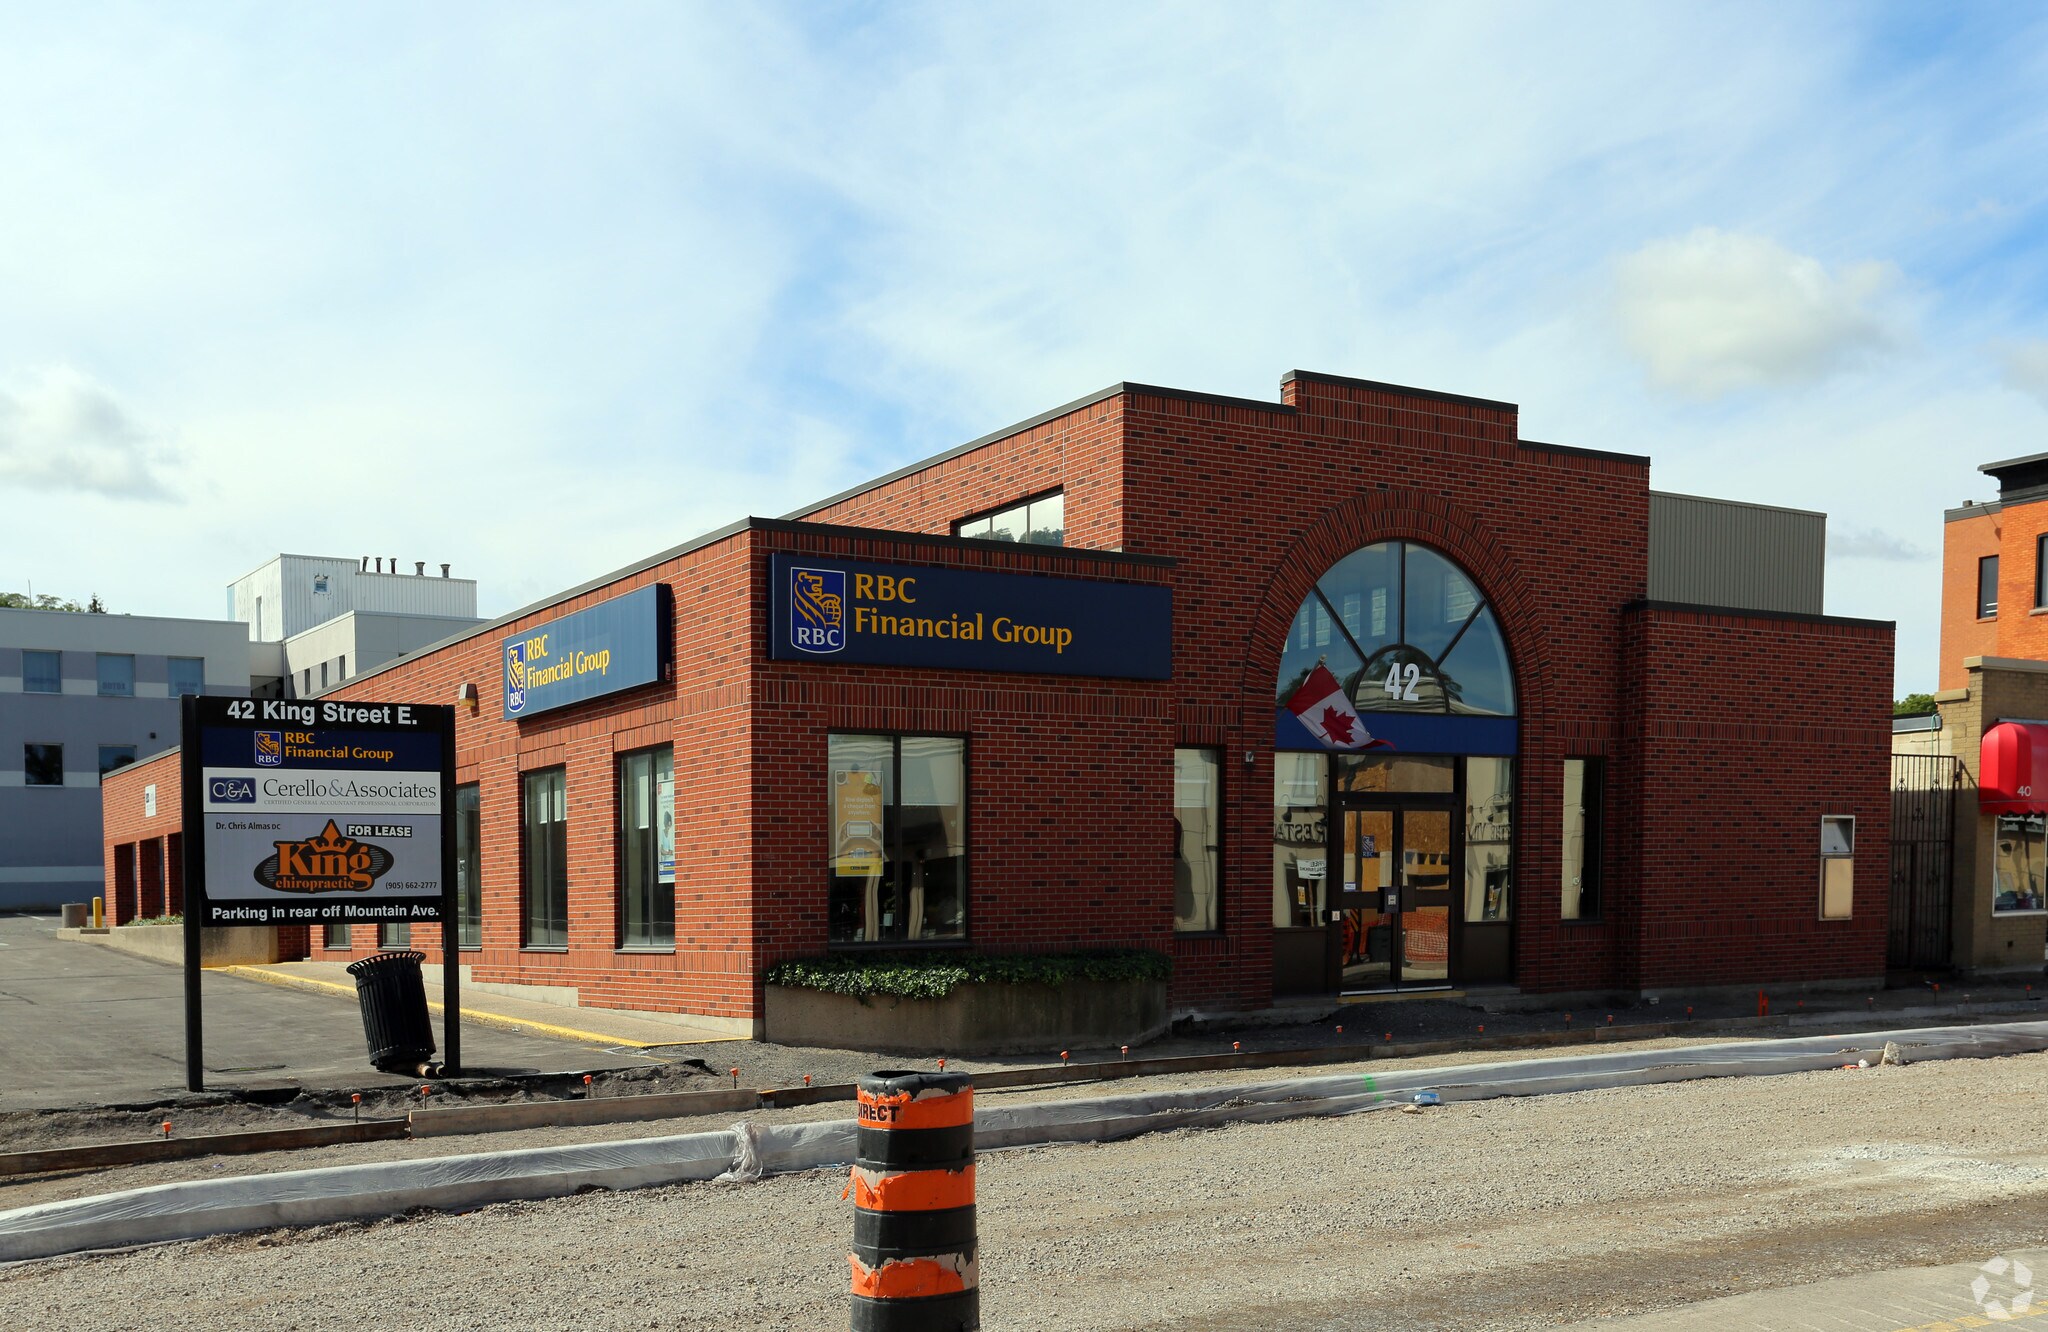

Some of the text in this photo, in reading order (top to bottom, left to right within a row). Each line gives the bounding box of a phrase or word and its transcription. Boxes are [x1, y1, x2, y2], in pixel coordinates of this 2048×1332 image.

[854, 573, 916, 603] RBC
[797, 627, 840, 646] RBC
[854, 607, 1072, 653] Financial Group
[526, 634, 548, 661] RBC
[527, 649, 610, 689] Financial Group
[1384, 662, 1421, 701] 42
[509, 690, 523, 706] RBC
[227, 700, 418, 726] 42 King Street E.
[284, 732, 315, 744] RBC
[258, 755, 279, 763] RBC
[285, 745, 394, 762] Financial Group
[212, 780, 253, 801] C&A
[2017, 785, 2032, 796] 40
[216, 822, 226, 830] Dr.
[228, 822, 247, 830] Chris
[348, 826, 411, 837] FOR LEASE
[275, 843, 372, 889] King
[275, 877, 355, 891] chiropractic
[385, 881, 403, 890] (905)
[212, 904, 439, 921] Parking in rear off Mountain Ave.
